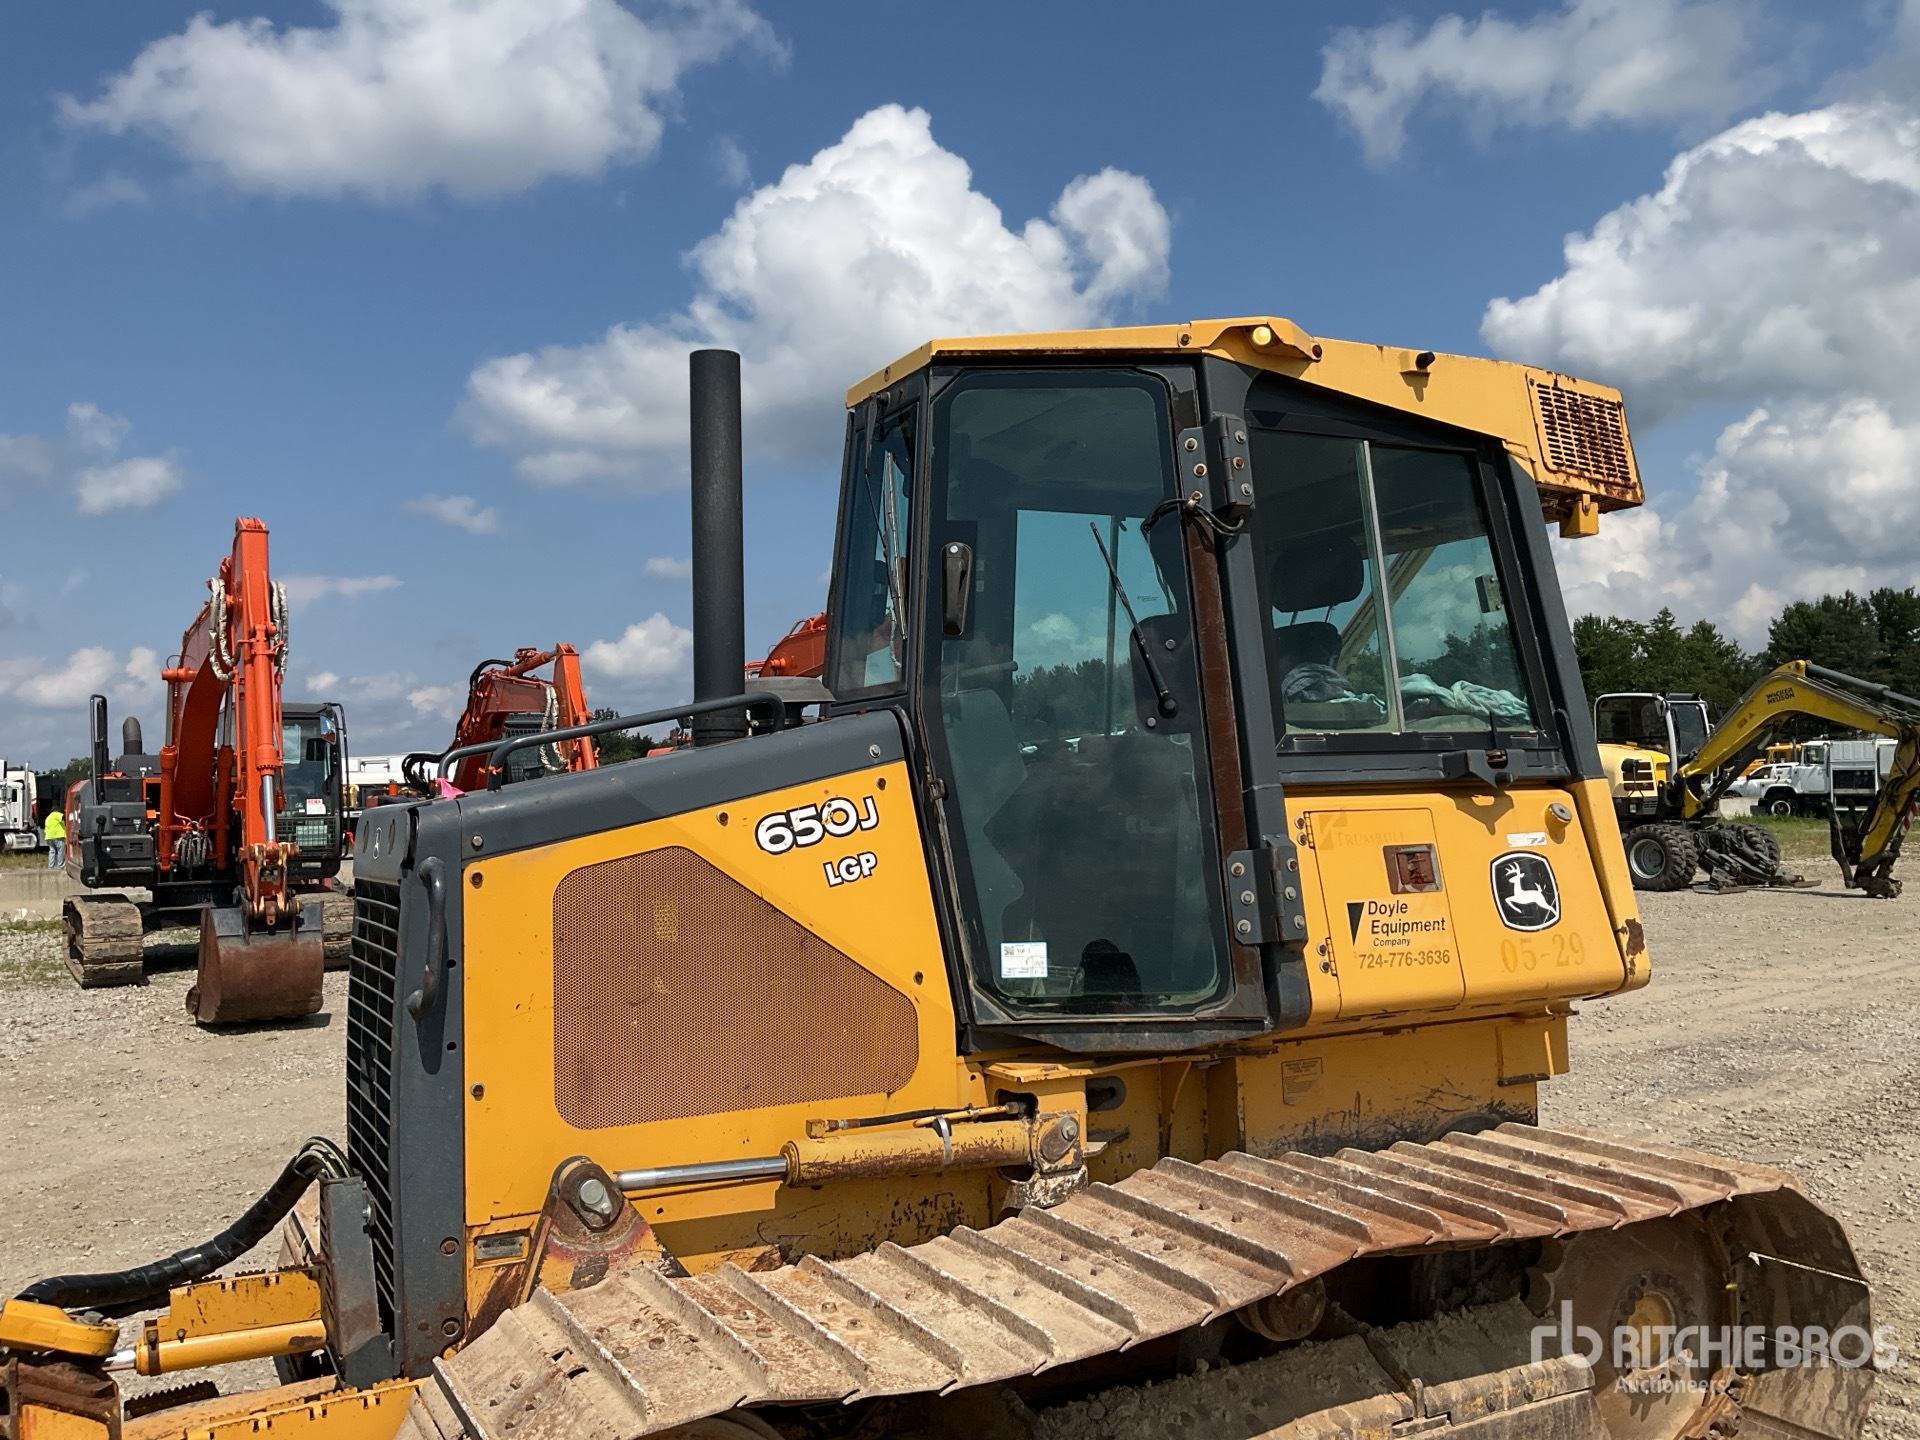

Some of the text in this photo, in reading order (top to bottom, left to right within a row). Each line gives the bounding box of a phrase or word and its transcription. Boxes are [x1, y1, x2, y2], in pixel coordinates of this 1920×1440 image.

[755, 795, 880, 855] 650J
[823, 851, 878, 887] LGP
[1368, 899, 1408, 917] Doyle
[1371, 917, 1446, 937] Equipment
[1373, 938, 1411, 947] Company
[1500, 931, 1586, 973] 05-29
[1358, 949, 1451, 969] 724-776-3636
